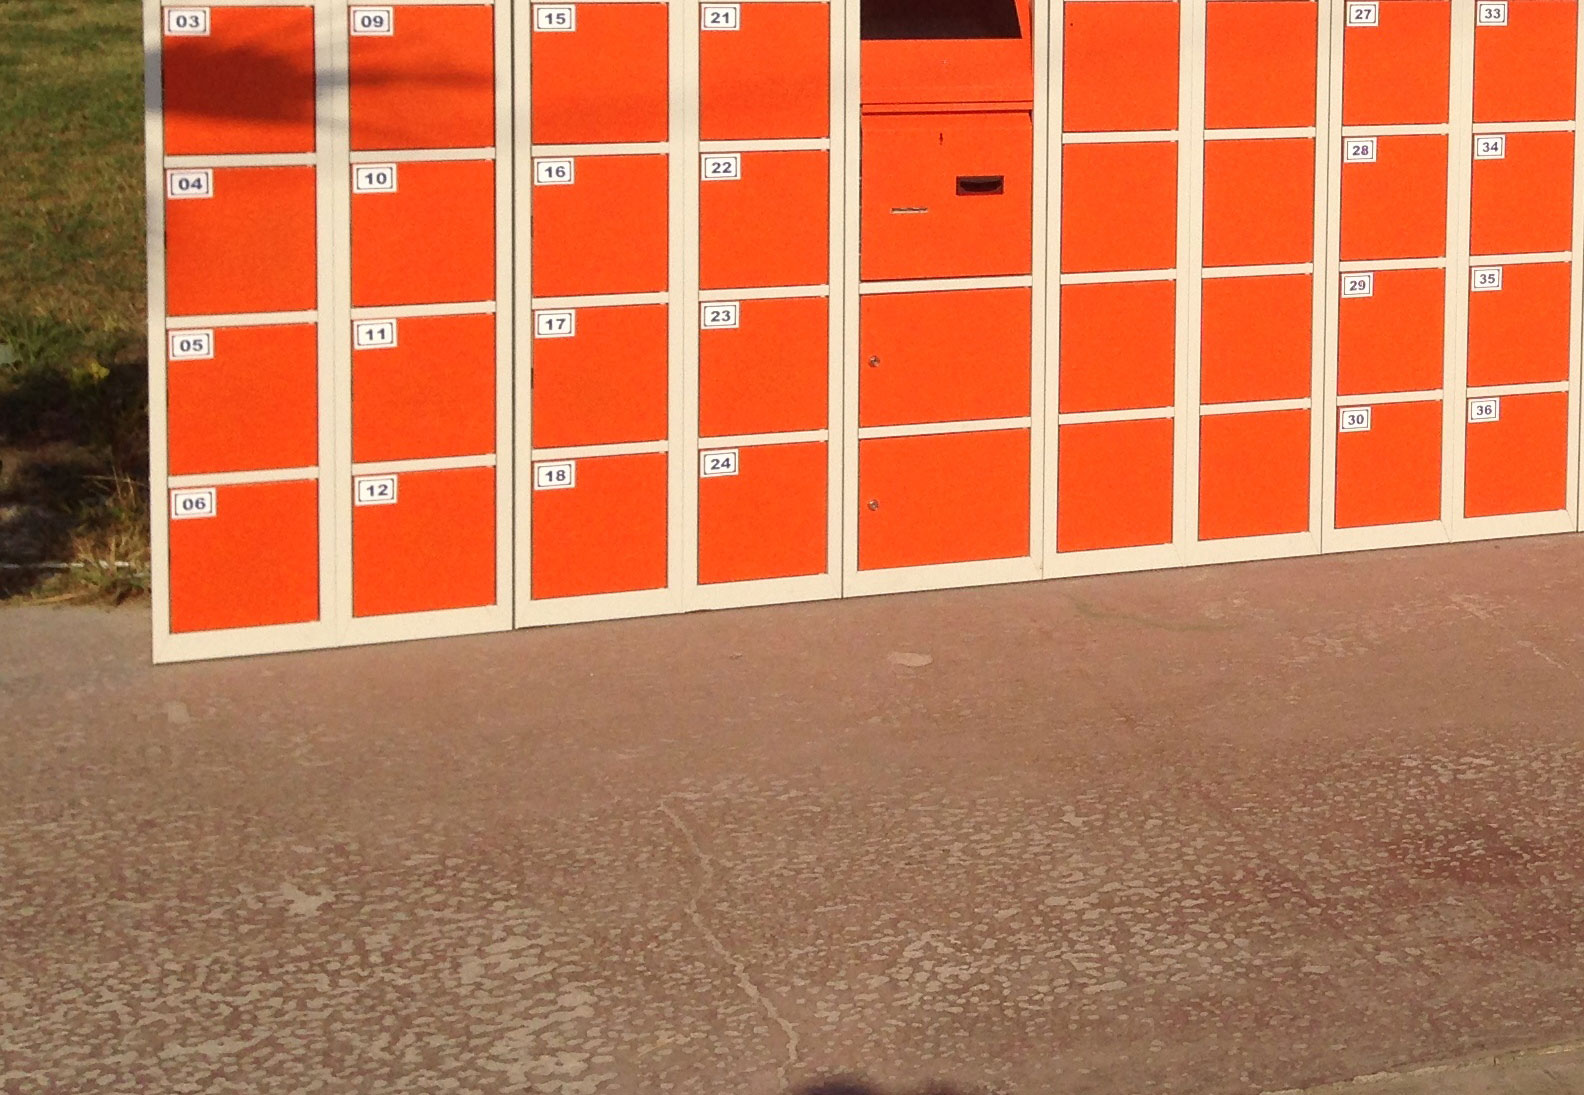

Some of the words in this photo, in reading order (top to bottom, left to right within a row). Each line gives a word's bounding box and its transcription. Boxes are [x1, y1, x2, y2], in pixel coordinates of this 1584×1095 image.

[544, 12, 566, 25] 15
[710, 11, 729, 24] 21
[1354, 8, 1372, 20] 27
[1484, 8, 1501, 19] 33
[175, 15, 200, 28] 03
[360, 15, 384, 28] 09
[1352, 144, 1369, 156] 28
[1482, 141, 1499, 153] 34
[544, 165, 566, 178] 16
[711, 161, 732, 174] 22
[178, 177, 203, 191] 04
[364, 172, 387, 185] 10
[1349, 279, 1366, 292] 29
[1479, 273, 1496, 285] 35
[710, 310, 731, 323] 23
[545, 318, 566, 331] 17
[365, 328, 385, 341] 11
[179, 339, 204, 352] 05
[1476, 404, 1493, 416] 36
[1347, 414, 1365, 426] 30
[710, 457, 731, 471] 24
[545, 469, 566, 482] 18
[366, 483, 388, 497] 12
[182, 497, 206, 511] 06
